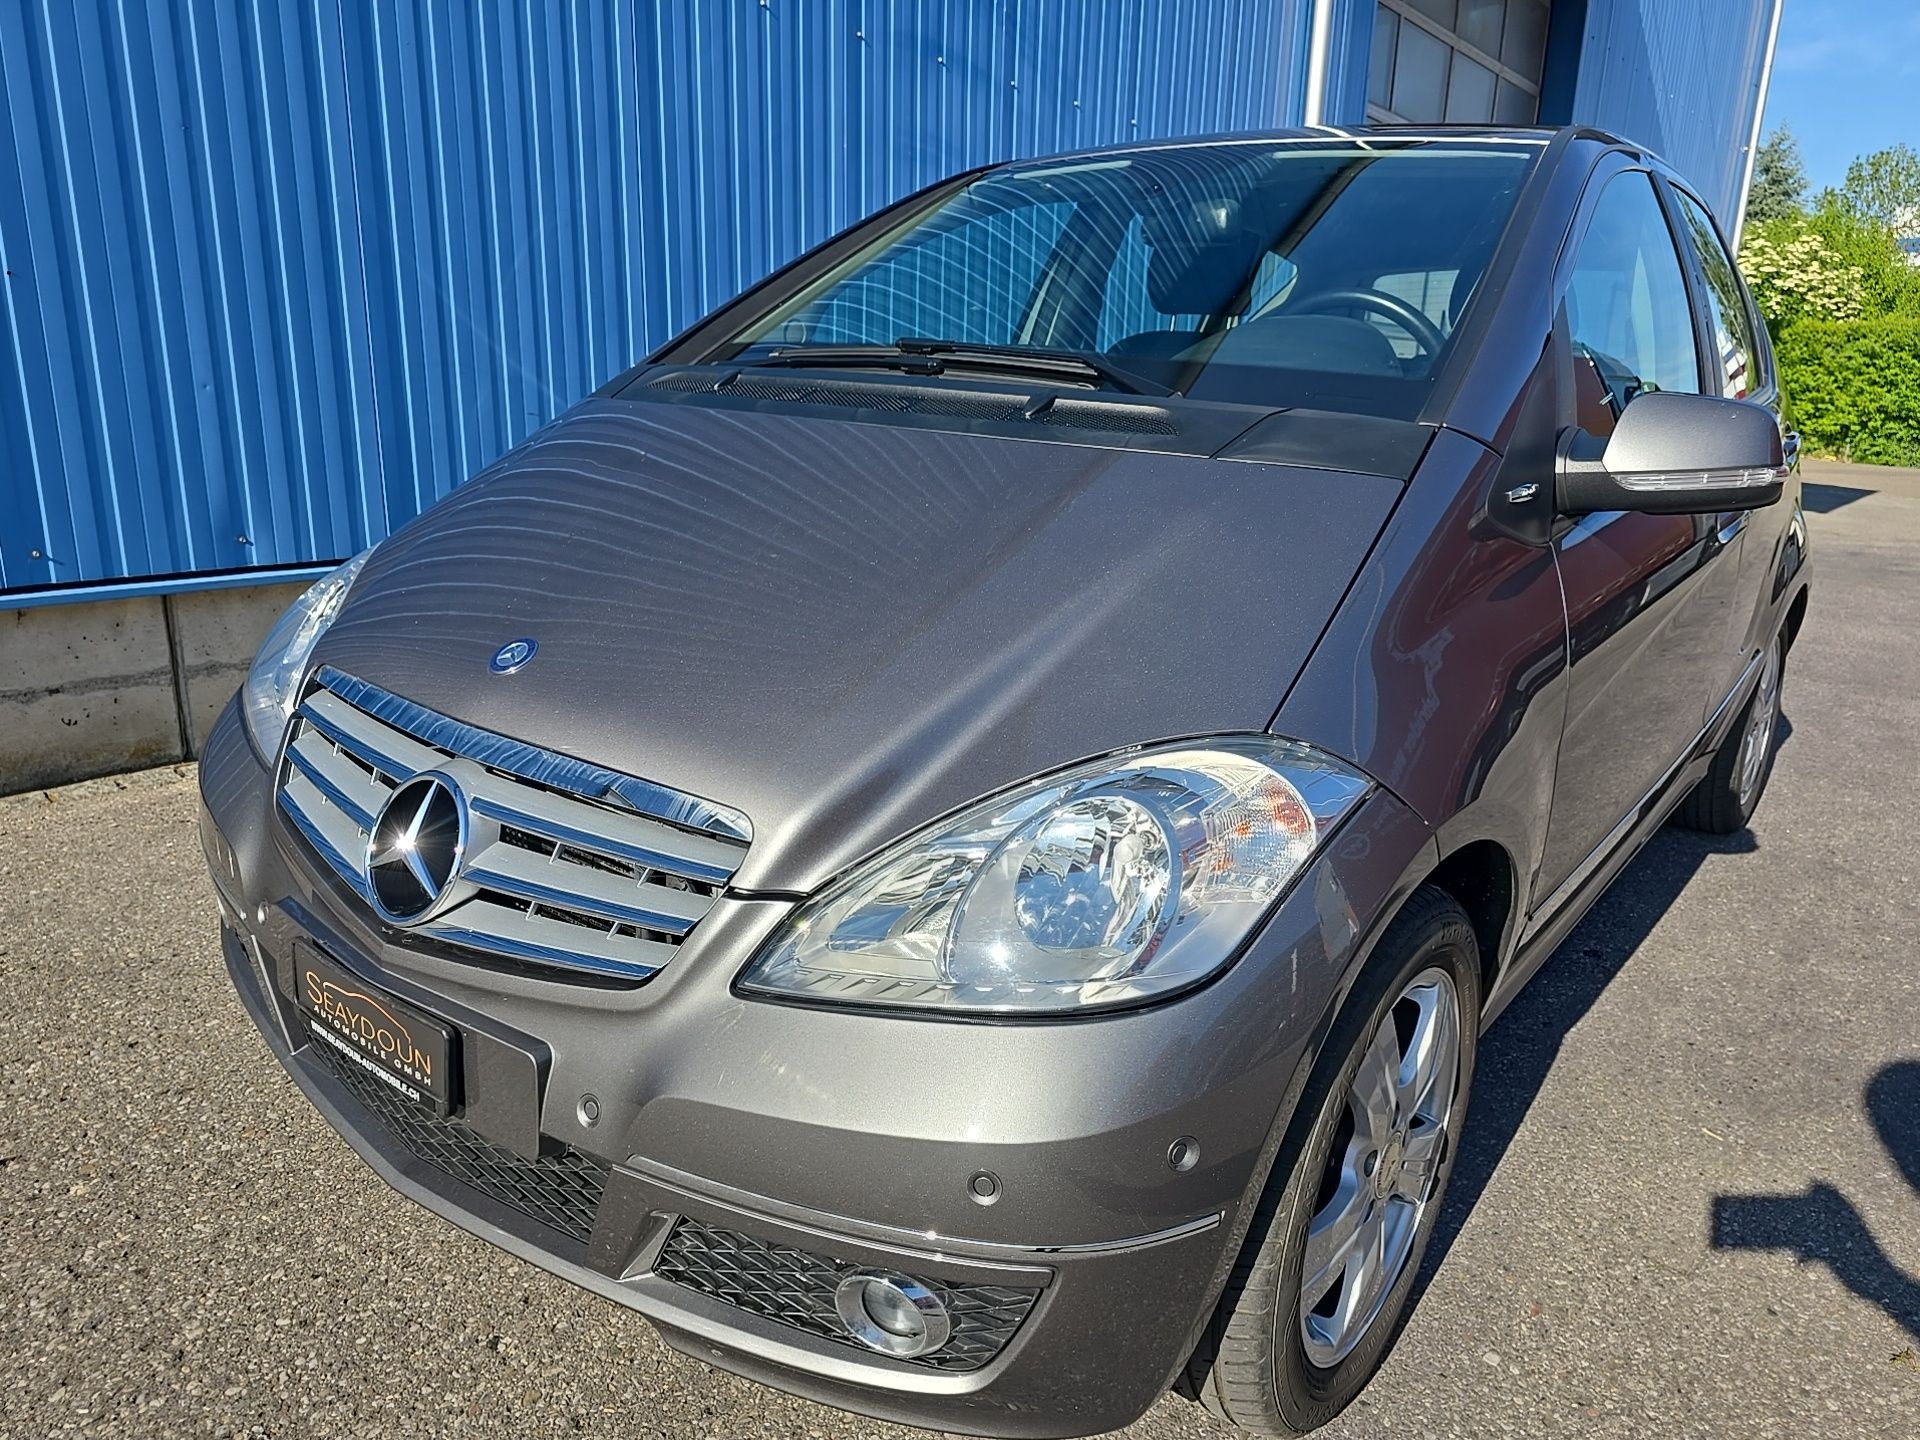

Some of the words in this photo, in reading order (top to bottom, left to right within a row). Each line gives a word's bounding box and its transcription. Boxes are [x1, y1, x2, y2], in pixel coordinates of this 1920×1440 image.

[306, 971, 431, 1075] SEAYDOUN
[313, 1005, 387, 1059] AUTOMOBILE
[394, 1059, 431, 1086] GMBH
